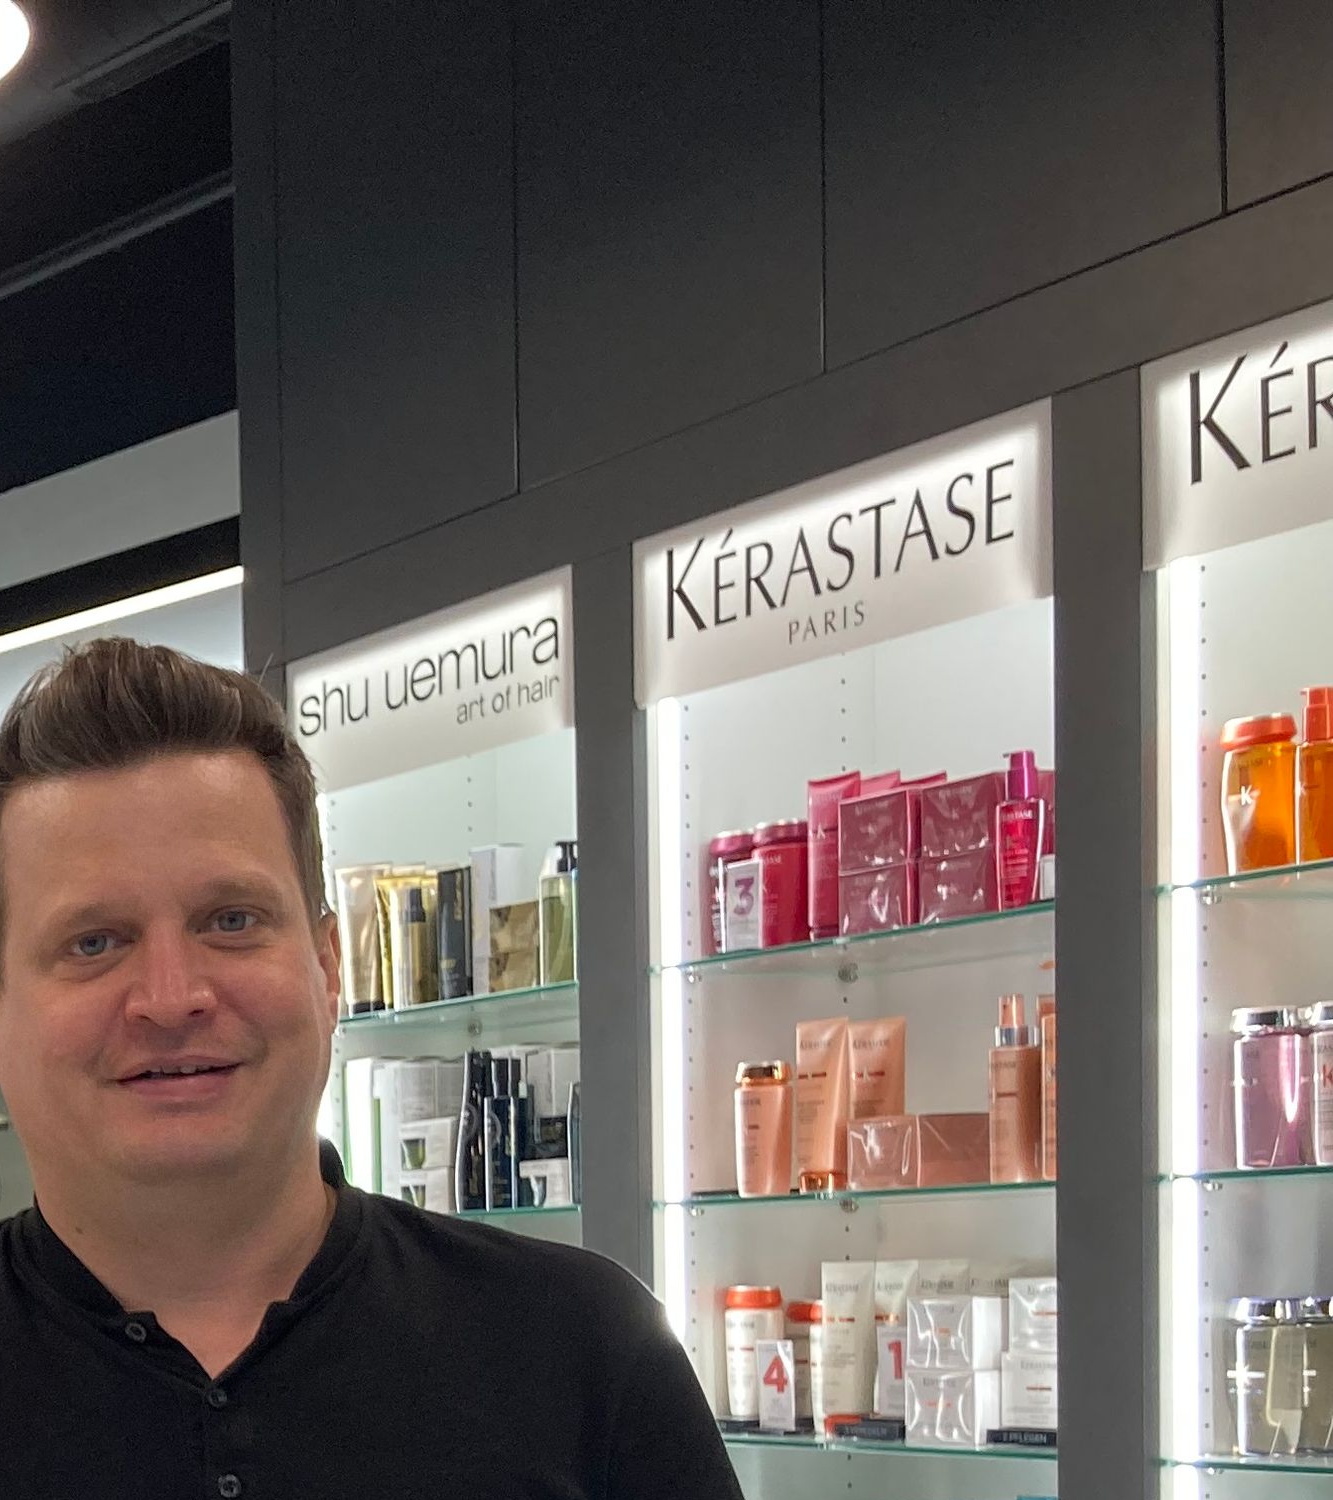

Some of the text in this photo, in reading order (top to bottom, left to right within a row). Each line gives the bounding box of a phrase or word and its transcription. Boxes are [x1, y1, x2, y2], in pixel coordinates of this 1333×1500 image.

[666, 457, 1015, 641] KÉRASTASE
[788, 600, 866, 645] PARIS
[299, 616, 560, 737] shu uemura
[456, 674, 561, 725] art of hair
[762, 1356, 789, 1394] 4
